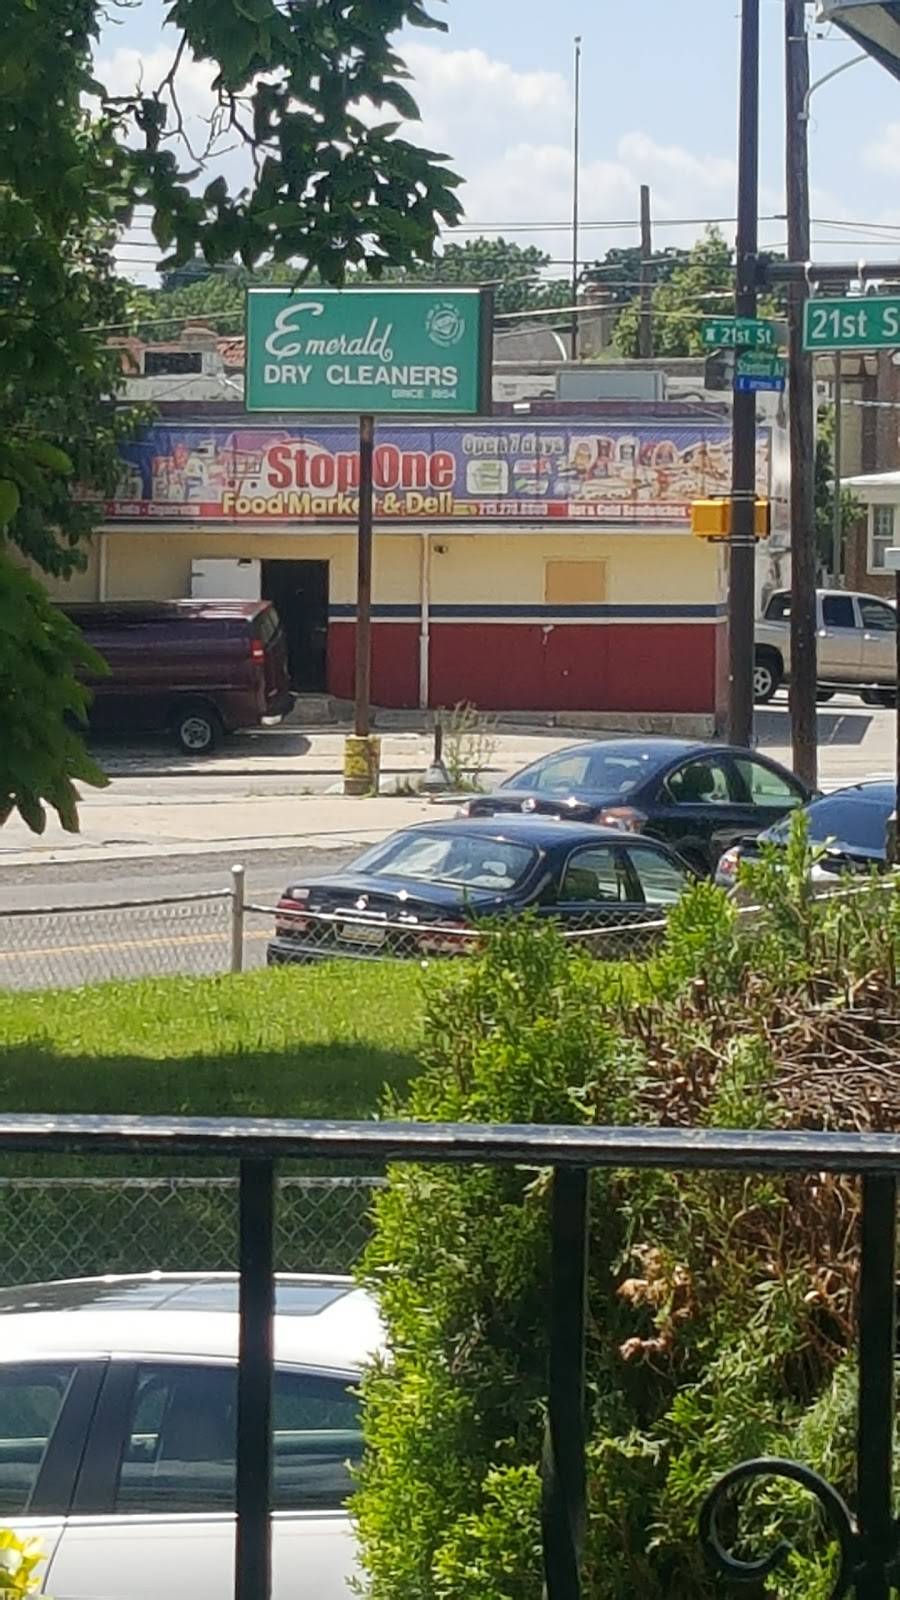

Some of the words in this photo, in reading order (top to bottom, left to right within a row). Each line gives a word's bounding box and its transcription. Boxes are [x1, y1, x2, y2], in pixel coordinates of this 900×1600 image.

[265, 302, 393, 362] Emerald
[811, 308, 867, 339] 21st
[881, 306, 899, 338] S
[721, 327, 750, 344] 21st
[756, 328, 771, 344] St
[264, 365, 311, 385] DRY
[326, 366, 458, 386] CLEANERS
[391, 388, 425, 399] SINCE
[462, 432, 508, 456] Open
[509, 432, 520, 454] 7
[267, 445, 361, 492] Stop
[372, 443, 454, 489] One
[223, 492, 282, 515] Food
[382, 491, 400, 514] &
